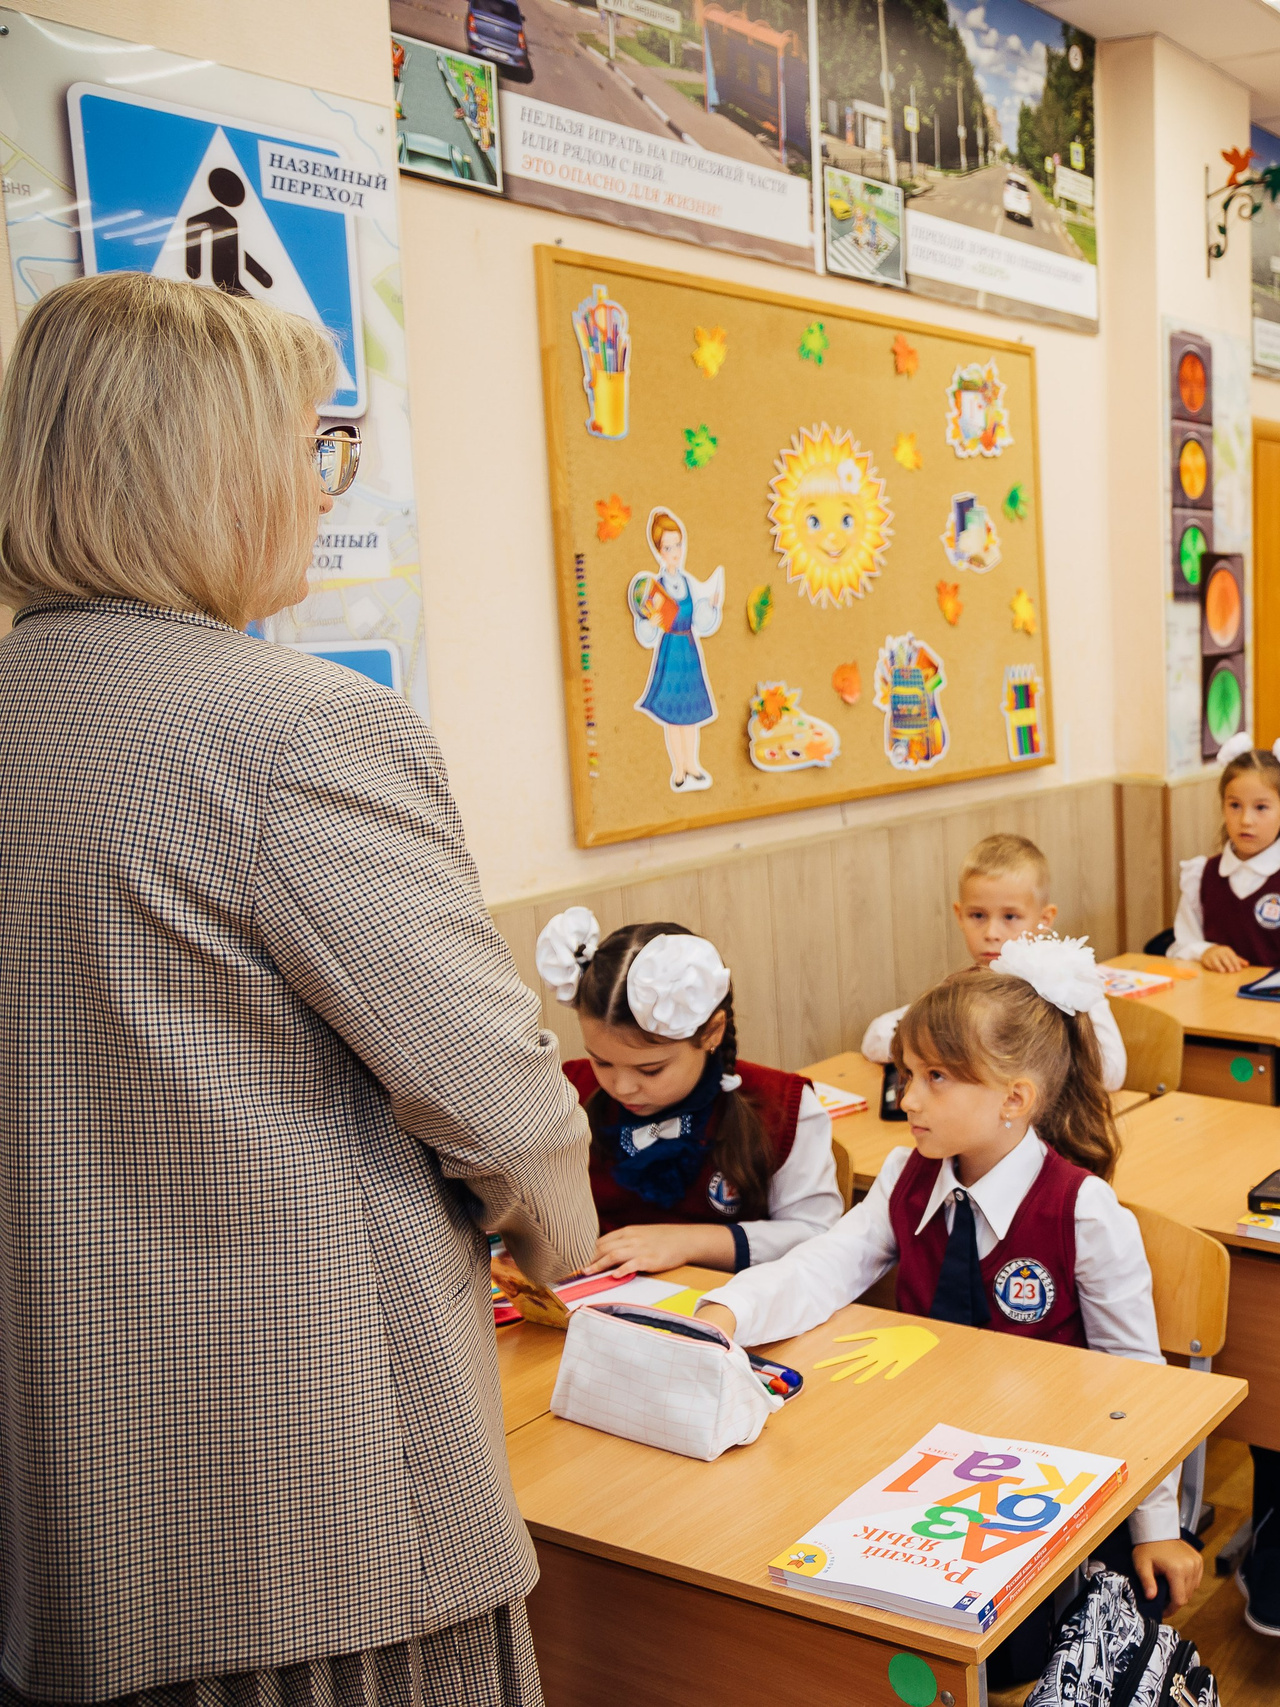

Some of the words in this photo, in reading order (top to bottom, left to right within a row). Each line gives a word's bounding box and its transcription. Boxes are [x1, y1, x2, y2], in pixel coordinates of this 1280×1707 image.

[269, 152, 388, 191] НАЗЕМНЫЙ
[520, 106, 585, 137] НЕЛЬЗЯ
[587, 128, 643, 154] ИГРАТЬ
[648, 142, 667, 162] НА
[670, 150, 744, 183] ПРОЕЗЖЕЙ
[746, 170, 788, 195] ЧАСТИ
[521, 130, 559, 153] ИЛИ
[562, 140, 617, 170] РЯДОМ
[619, 156, 631, 172] С
[632, 159, 666, 183] НЕЙ.
[271, 174, 364, 208] ПЕРЕХОД
[521, 154, 557, 176] ЭТО
[558, 164, 626, 193] ОПАСНО
[628, 182, 660, 203] ДЛЯ
[1013, 1281, 1036, 1300] 23
[881, 1451, 954, 1494] 1
[861, 1544, 979, 1586] Русский
[1004, 1575, 1023, 1592] Русский
